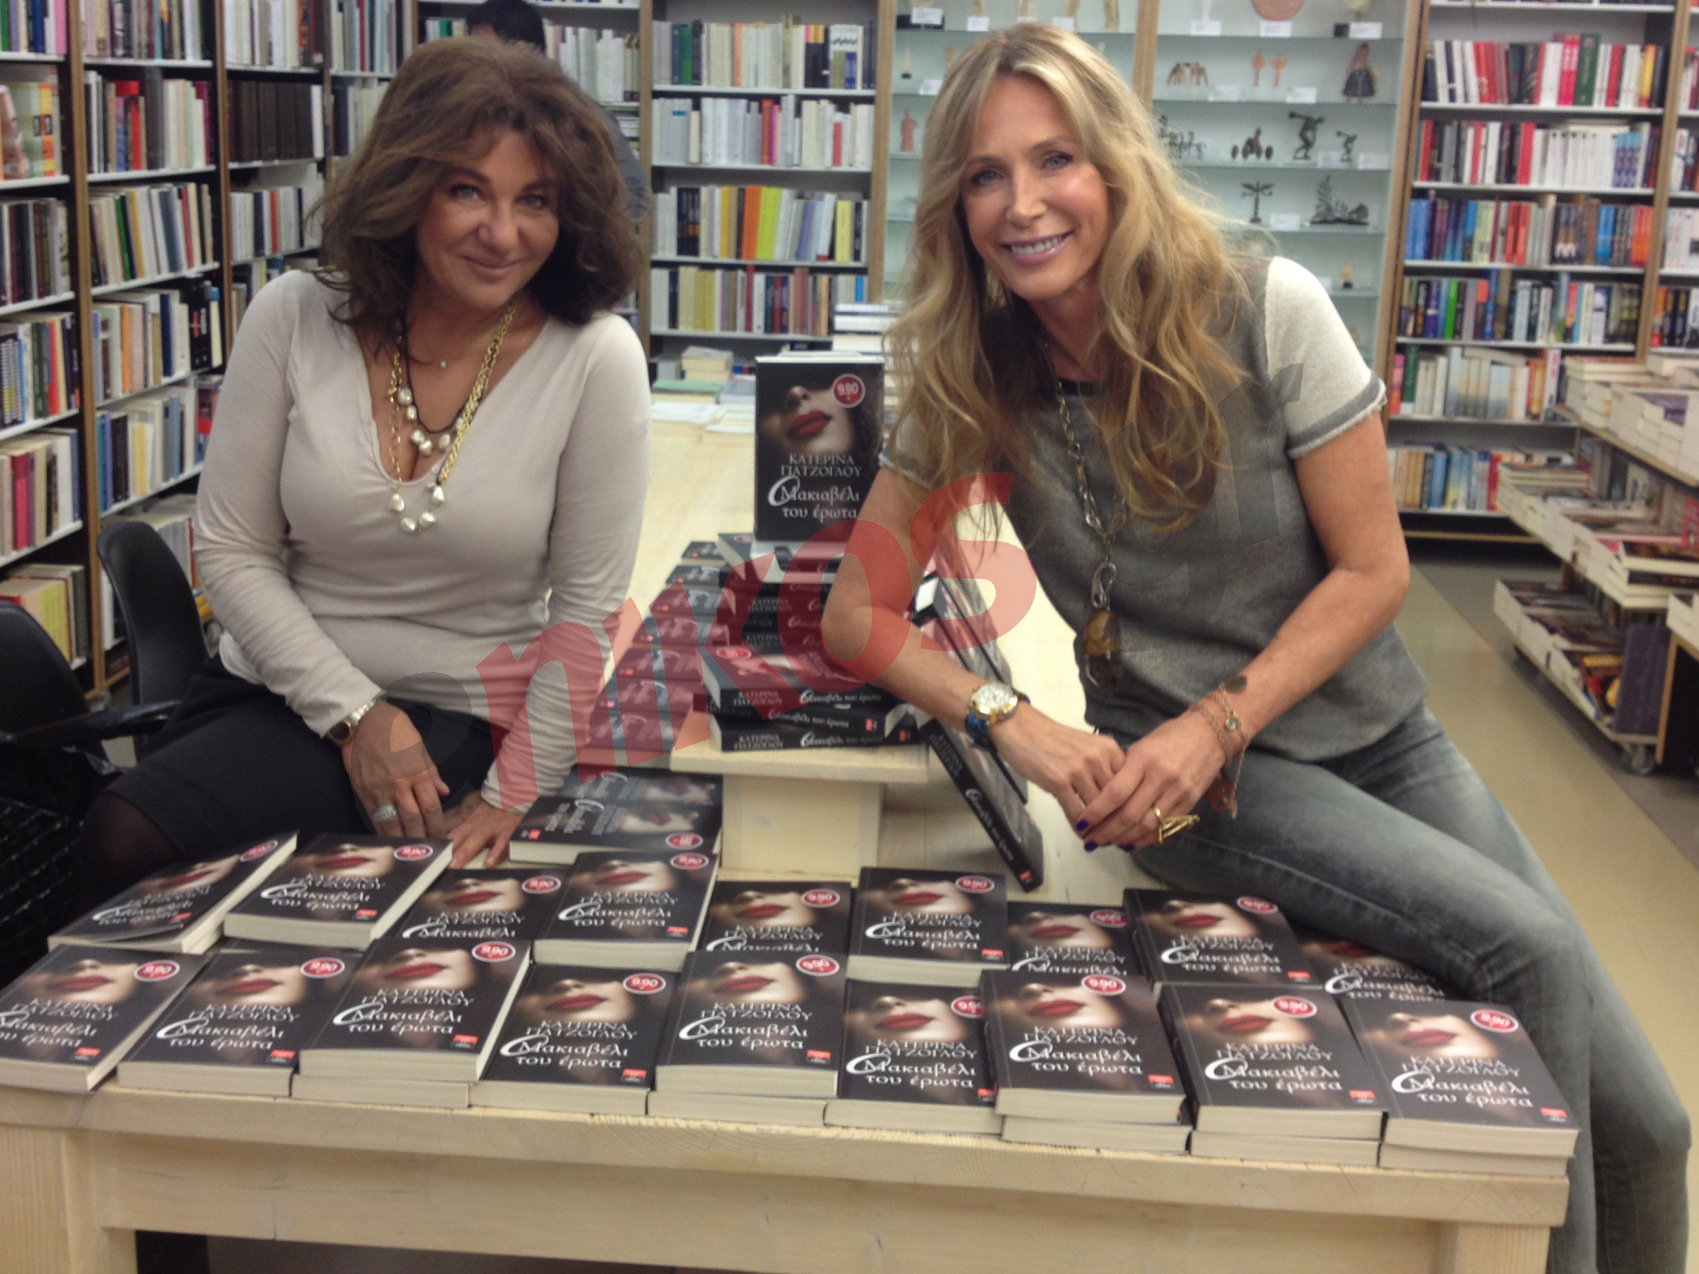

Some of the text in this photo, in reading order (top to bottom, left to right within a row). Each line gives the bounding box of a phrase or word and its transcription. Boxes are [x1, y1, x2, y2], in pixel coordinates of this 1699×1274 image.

[781, 485, 859, 506] Μακιαβέλι
[782, 504, 857, 523] του έρωτα
[351, 1009, 463, 1024] Μακιαβέλι
[348, 1021, 454, 1036] του έρωτα
[697, 1024, 808, 1039] Μακιαβέλι
[519, 1041, 628, 1057] Μακιαβέλι
[697, 1037, 804, 1051] του έρωτα
[516, 1055, 621, 1070] του έρωτα
[1027, 1047, 1143, 1063] Μακιαβέλι
[864, 1059, 976, 1076] Μακιαβέλι
[1031, 1061, 1143, 1076] του έρωτα
[1223, 1064, 1340, 1080] Μακιαβέλι
[865, 1074, 974, 1090] του έρωτα
[1229, 1079, 1343, 1094] του έρωτα
[1416, 1093, 1457, 1103] του
